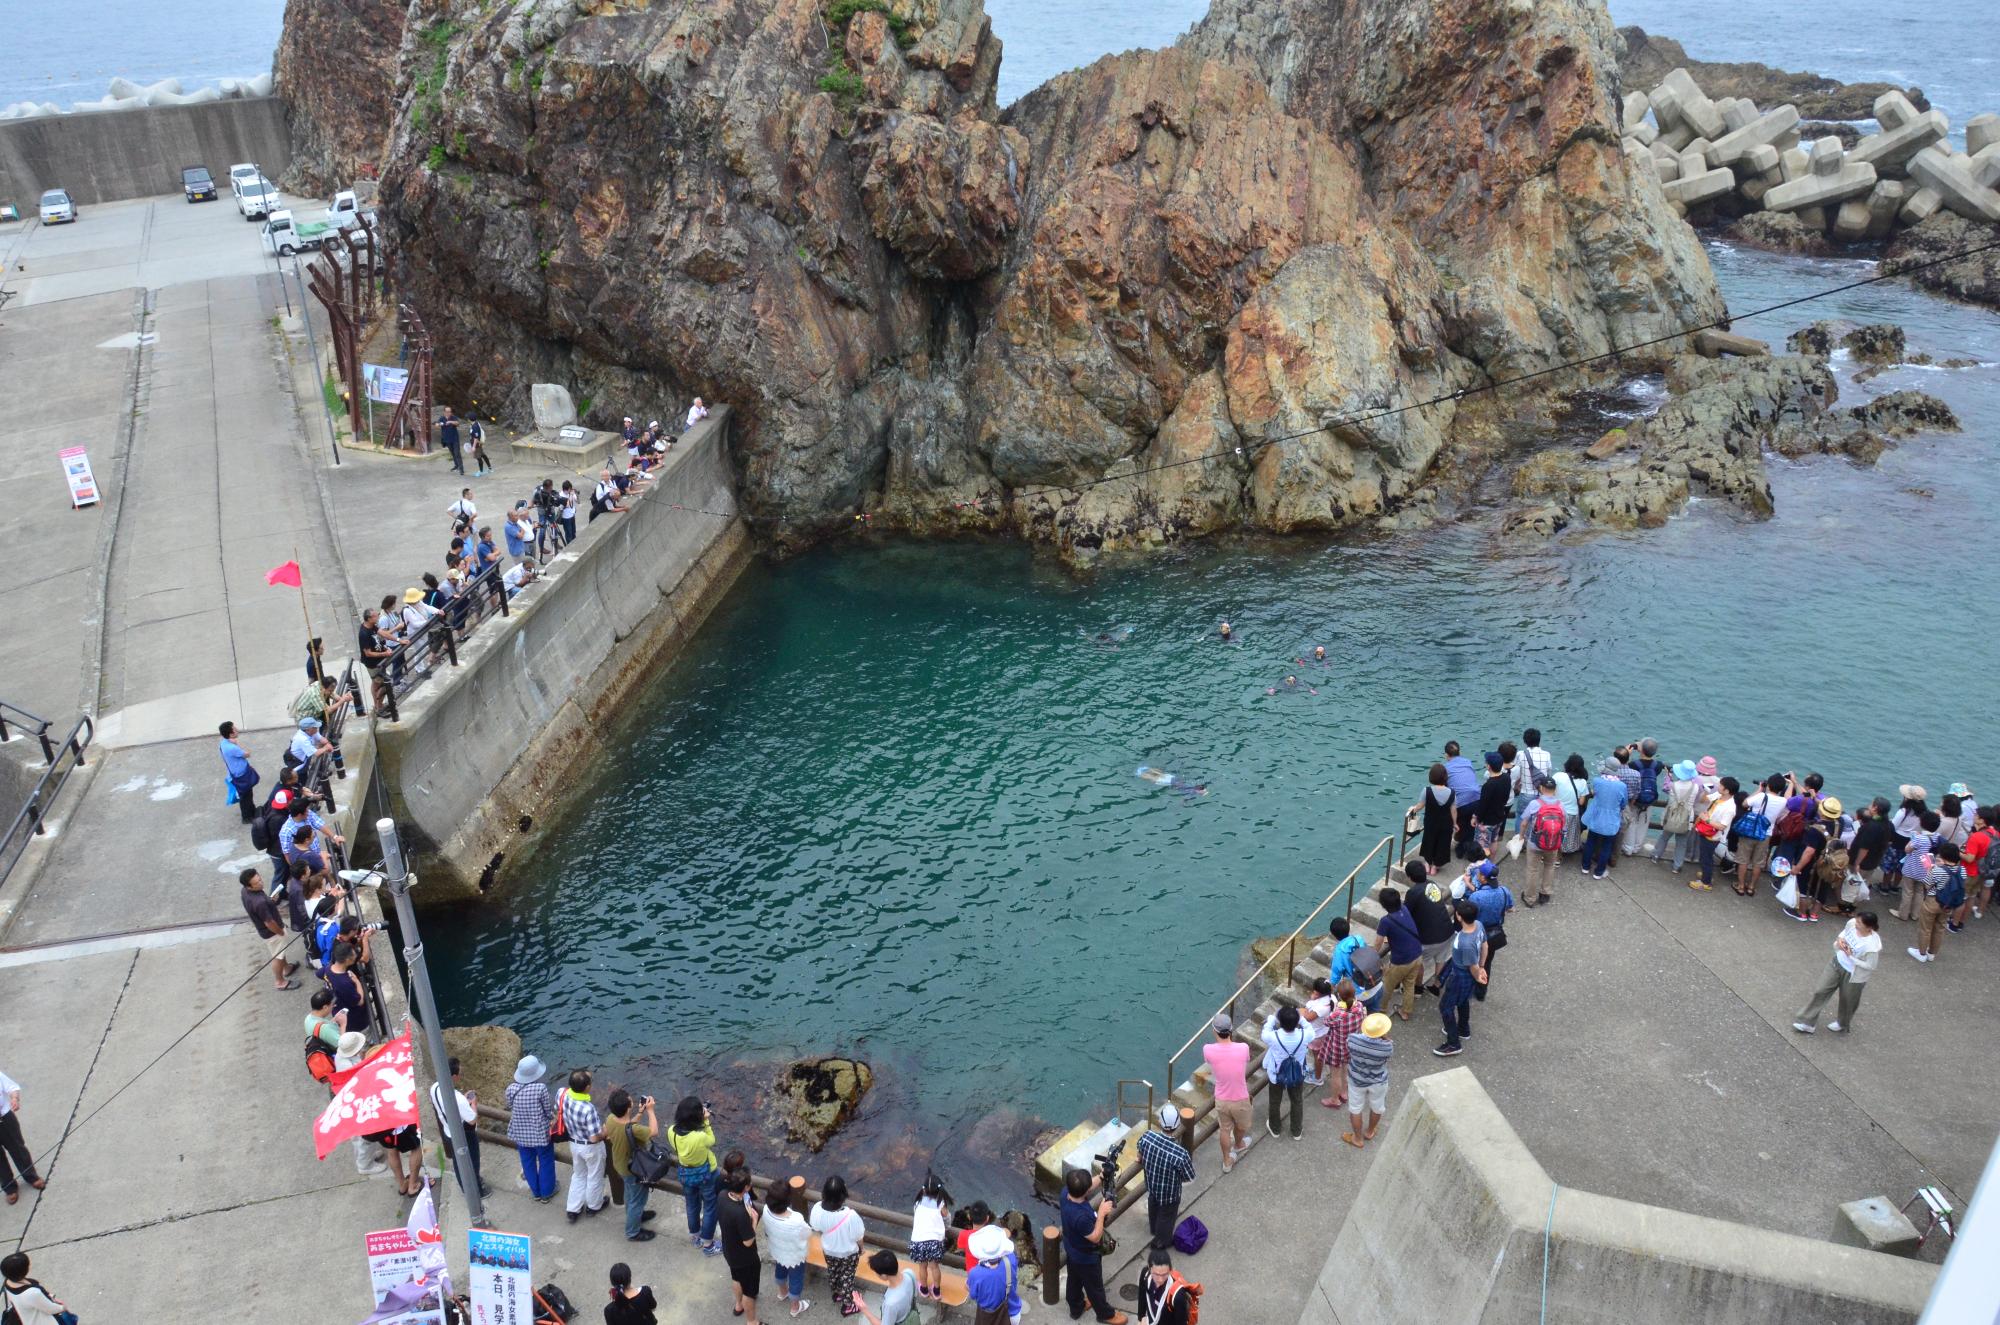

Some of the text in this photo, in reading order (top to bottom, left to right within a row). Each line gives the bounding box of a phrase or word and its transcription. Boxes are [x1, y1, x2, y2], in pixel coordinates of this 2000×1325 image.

[481, 1234, 520, 1246] 北限の海女
[476, 1241, 526, 1253] フェスティバル
